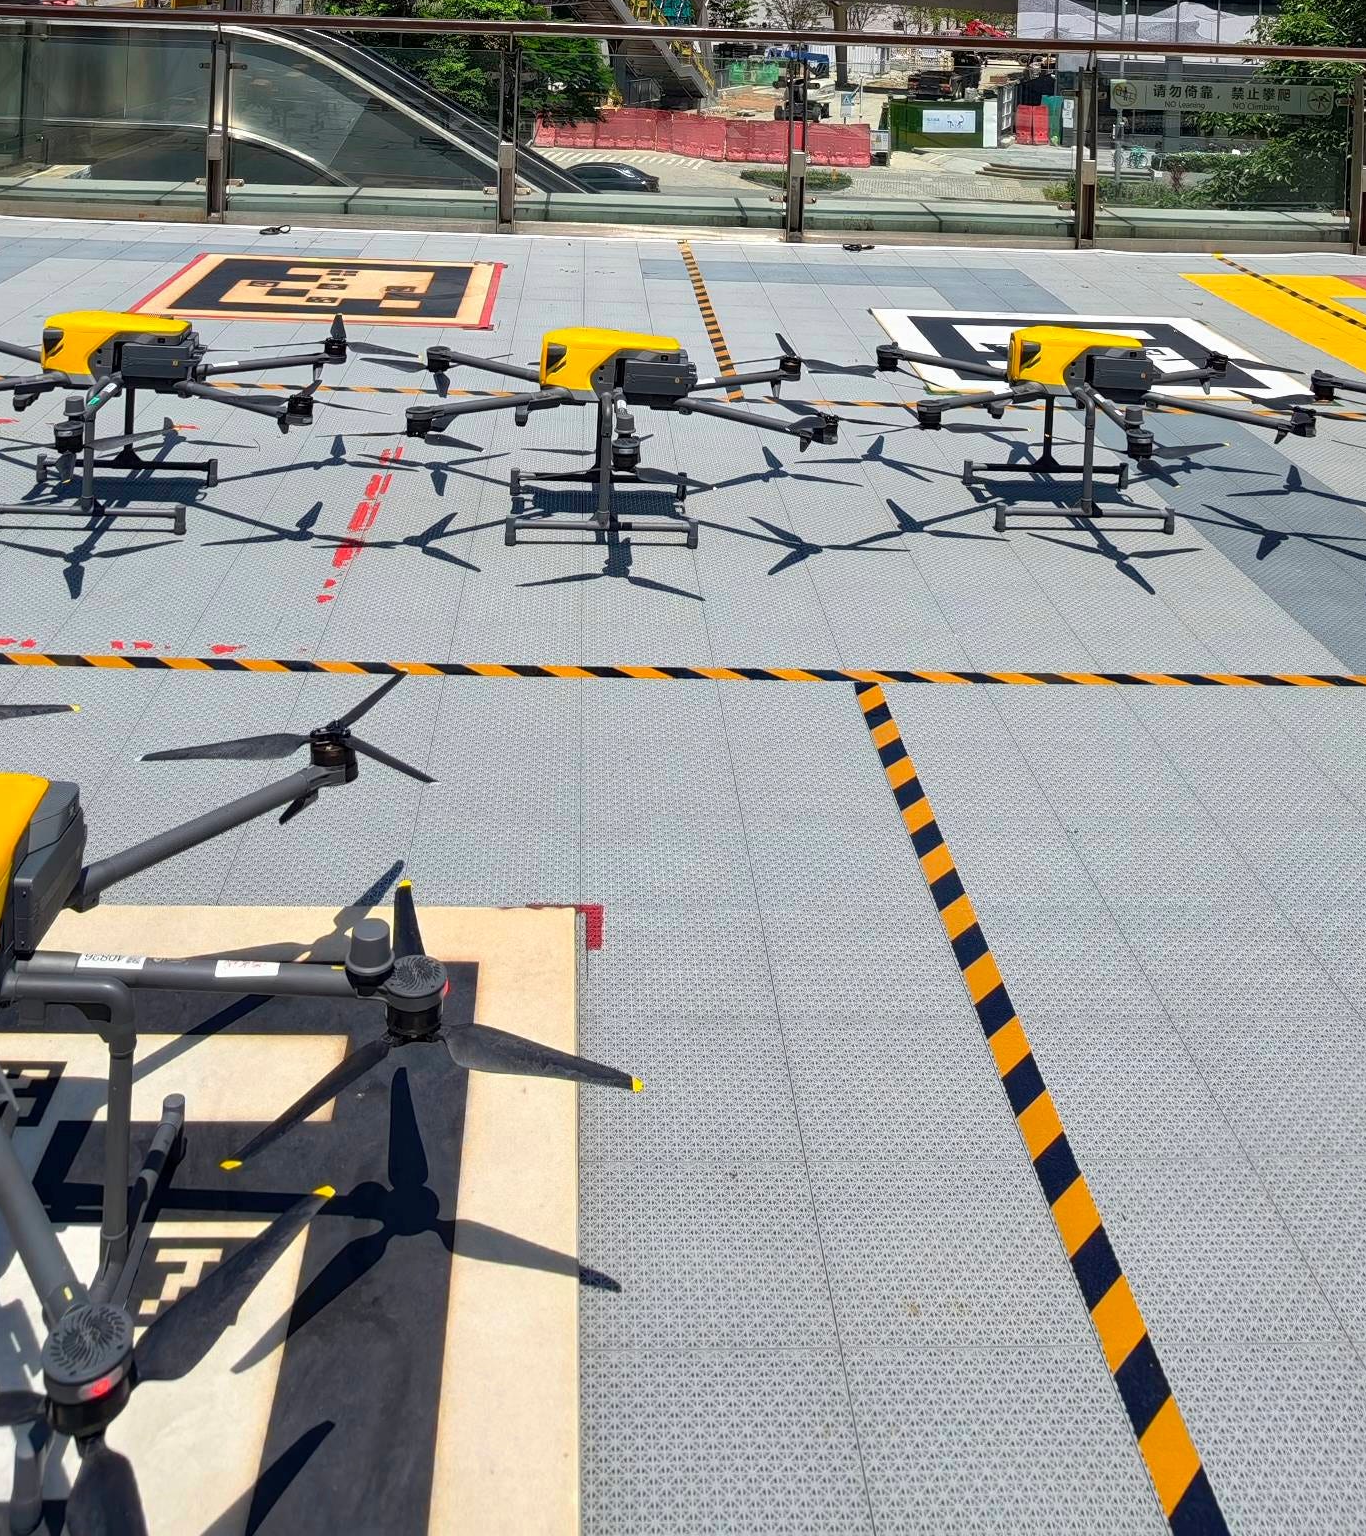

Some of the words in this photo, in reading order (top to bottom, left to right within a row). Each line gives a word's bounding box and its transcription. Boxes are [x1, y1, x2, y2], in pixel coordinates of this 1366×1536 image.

[1165, 101, 1176, 109] NO
[1179, 101, 1206, 110] Leaning
[1233, 102, 1246, 111] NO
[1247, 103, 1280, 112] Climbing
